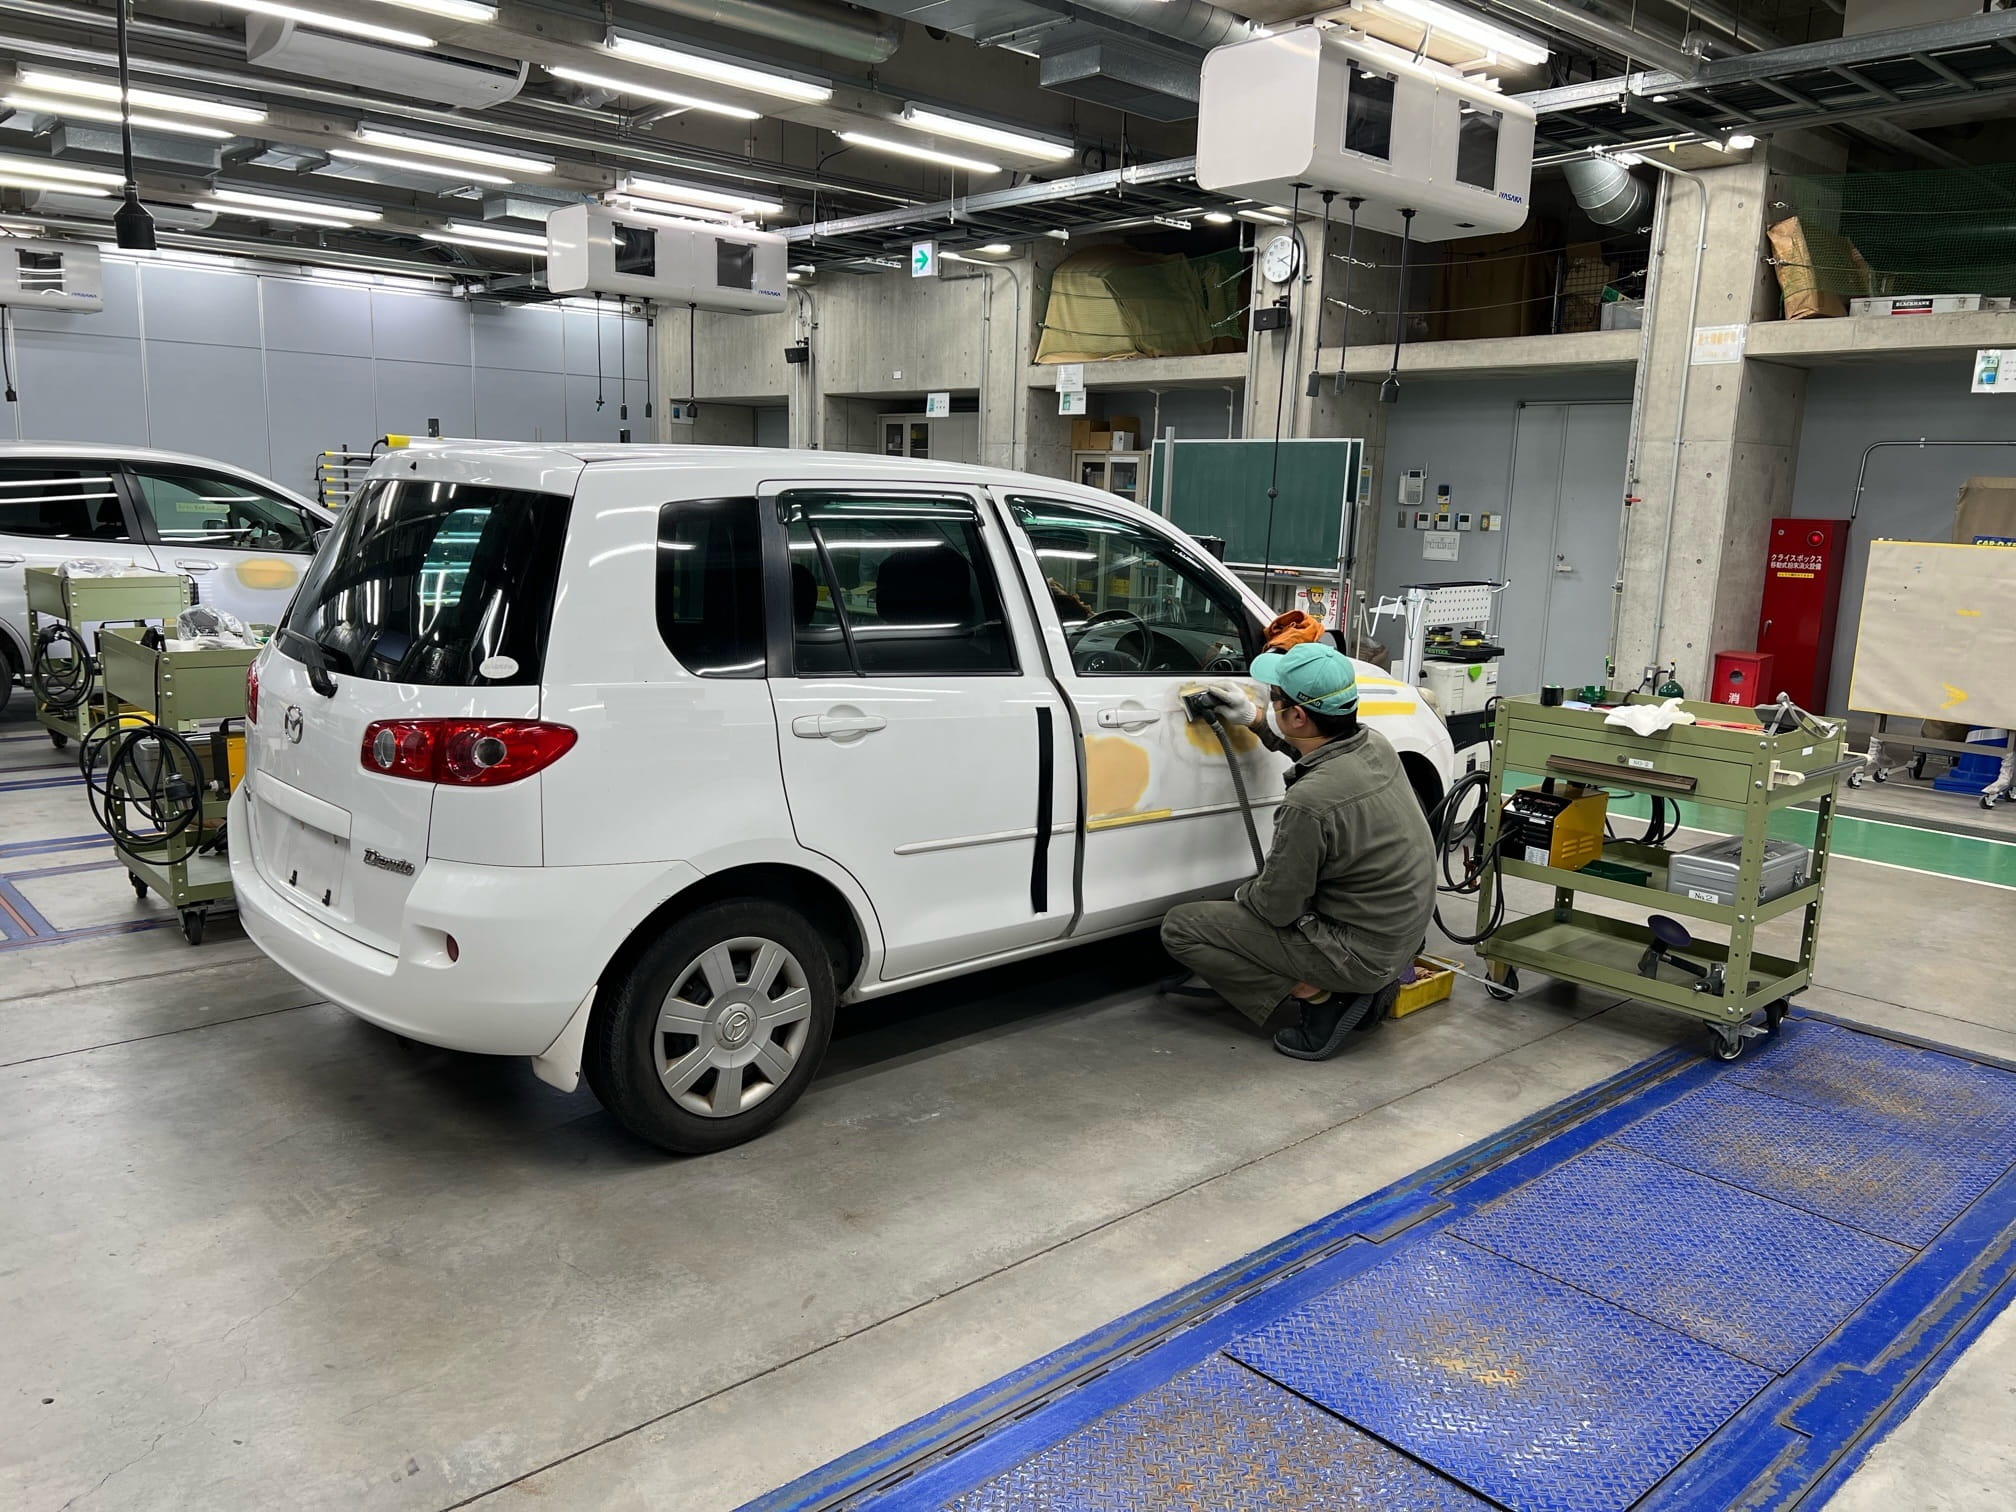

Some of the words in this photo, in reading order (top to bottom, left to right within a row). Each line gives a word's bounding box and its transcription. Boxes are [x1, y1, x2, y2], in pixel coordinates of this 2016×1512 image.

[1771, 554, 1823, 563] クライスボックス
[1728, 692, 1740, 704] 消
[363, 848, 415, 876] Demio
